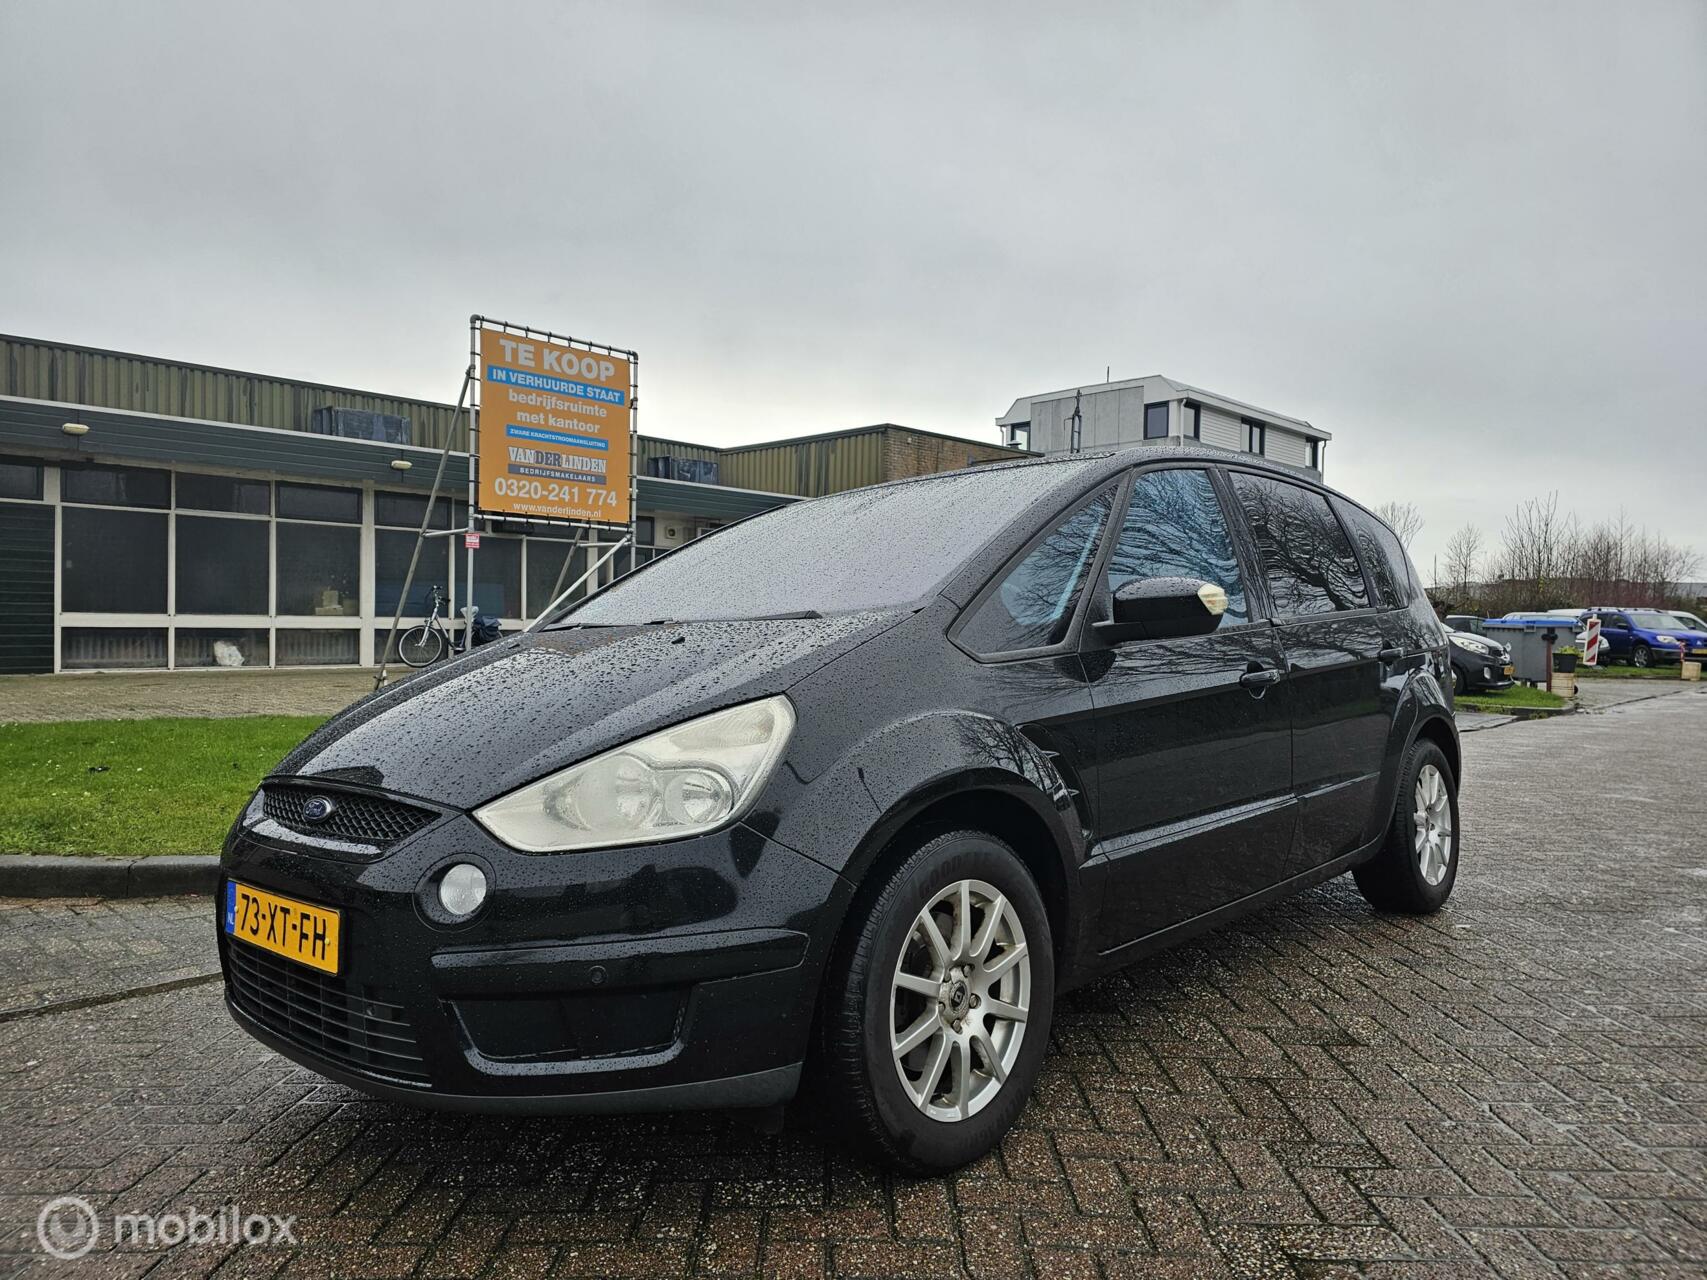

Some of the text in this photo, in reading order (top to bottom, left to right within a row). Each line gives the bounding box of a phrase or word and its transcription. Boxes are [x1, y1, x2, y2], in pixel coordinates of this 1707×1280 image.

[499, 338, 615, 382] TE KOOP
[492, 368, 621, 403] IN VERHUURDE STAAT
[508, 389, 607, 418] bedrijfsruimte
[517, 410, 601, 433] met kantoor
[519, 467, 596, 482] BEDRIJFSMAKELAARS
[494, 477, 617, 507] 0320-241 774
[513, 502, 601, 518] www.vanderlinden.nl
[240, 893, 328, 961] 73-XT-FH
